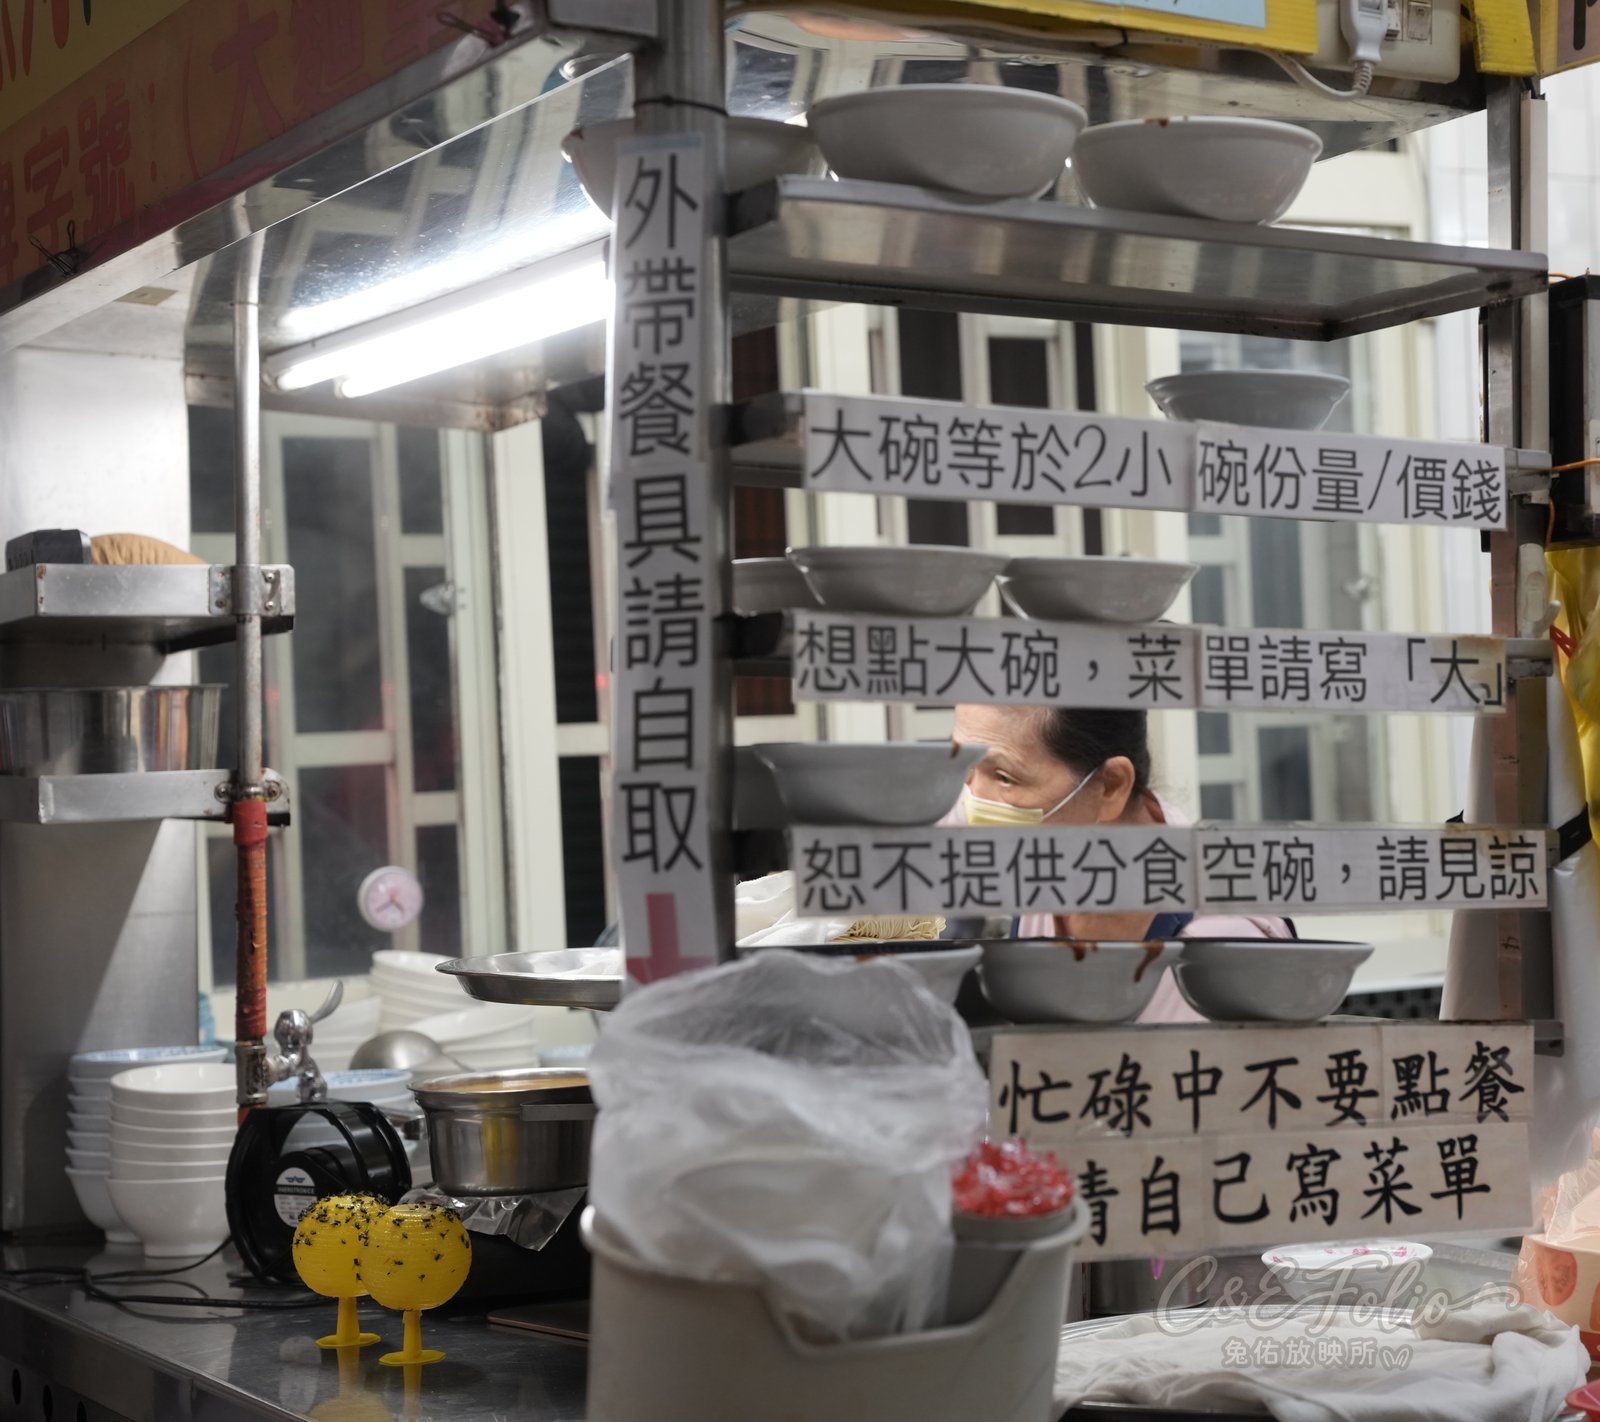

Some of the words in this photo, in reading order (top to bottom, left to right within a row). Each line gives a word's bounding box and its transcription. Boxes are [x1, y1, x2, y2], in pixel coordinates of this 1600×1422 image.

[619, 153, 704, 875] 外帶餐具請自取
[809, 407, 1504, 525] 大碗等於2小碗份量/價錢
[802, 835, 1541, 912] 恕不提供分食空碗，請見諒
[998, 1041, 1526, 1139] 忙碌中不要點餐
